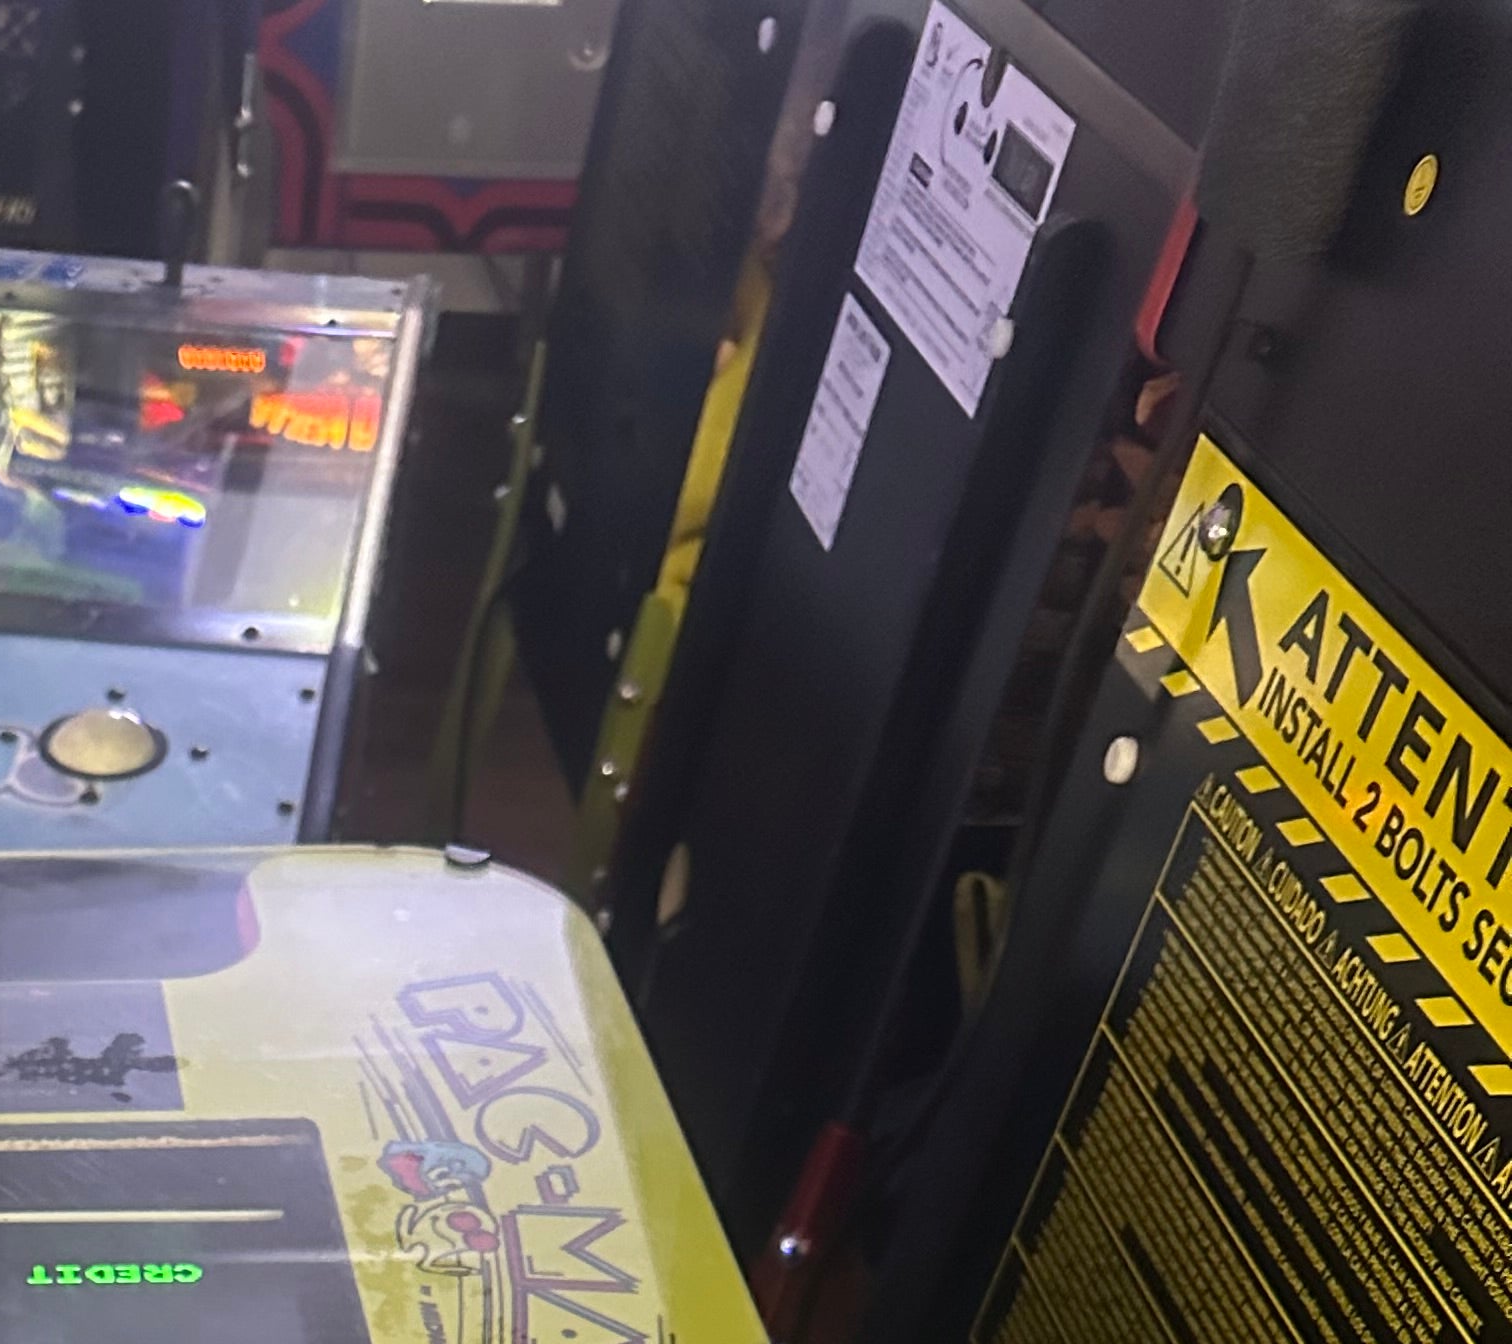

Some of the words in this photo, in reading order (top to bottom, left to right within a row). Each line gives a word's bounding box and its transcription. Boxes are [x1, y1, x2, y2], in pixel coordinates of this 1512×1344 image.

[1257, 667, 1356, 809] INSTALL
[1352, 781, 1381, 832] 2
[1375, 804, 1470, 932] BOLTS
[1209, 785, 1264, 863] CAUTION
[1268, 861, 1326, 945] CUIDADO
[1331, 947, 1400, 1041] ACHTUNG
[1403, 1041, 1488, 1154] ATTENTION
[27, 1263, 202, 1286] CREDIT
